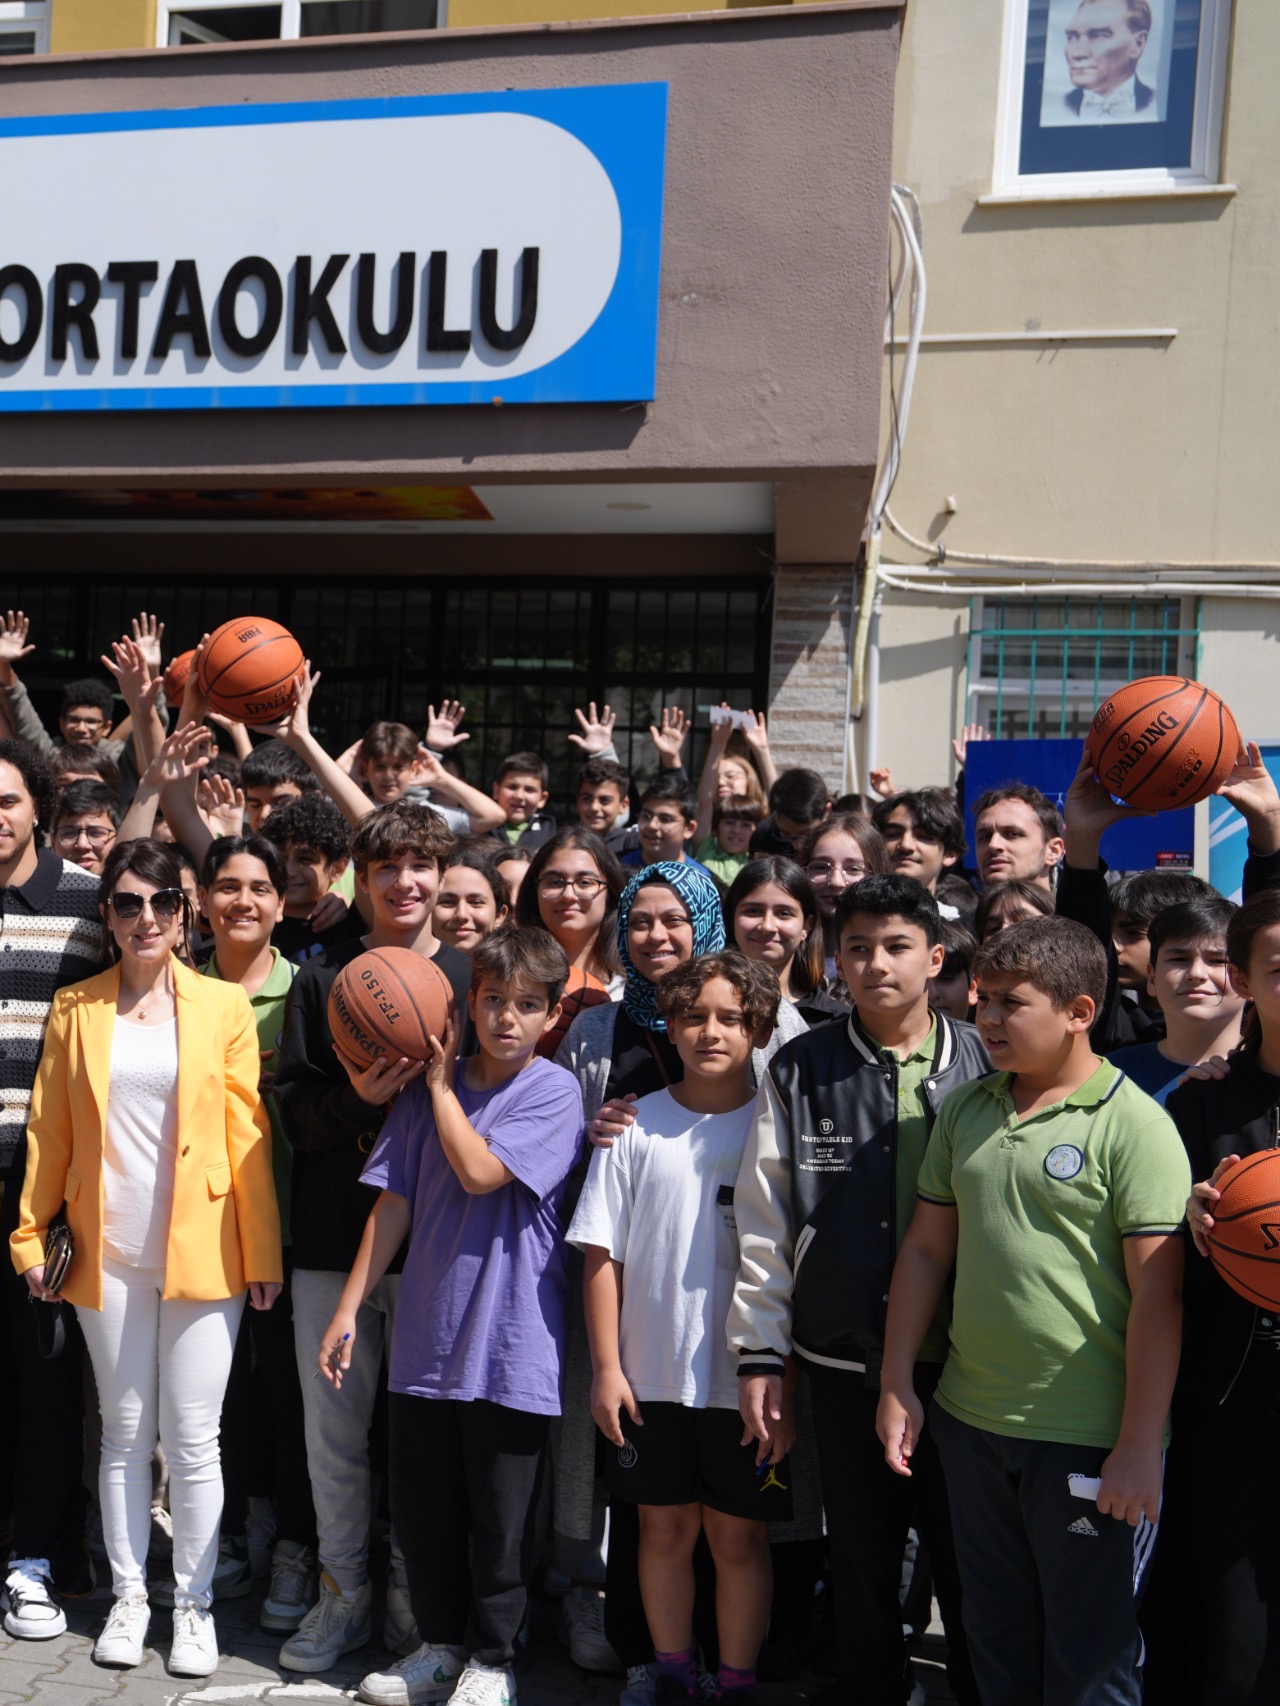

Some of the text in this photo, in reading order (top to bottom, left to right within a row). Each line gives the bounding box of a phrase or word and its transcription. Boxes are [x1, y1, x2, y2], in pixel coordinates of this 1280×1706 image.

[238, 627, 262, 643] FIBA
[244, 691, 294, 715] SPALD
[1105, 711, 1180, 789] SPALDING
[361, 970, 400, 1025] TF-150
[332, 981, 387, 1059] SPALDING
[801, 1134, 840, 1143] UNSTOPPABLE
[1067, 1525, 1099, 1537] adidas
